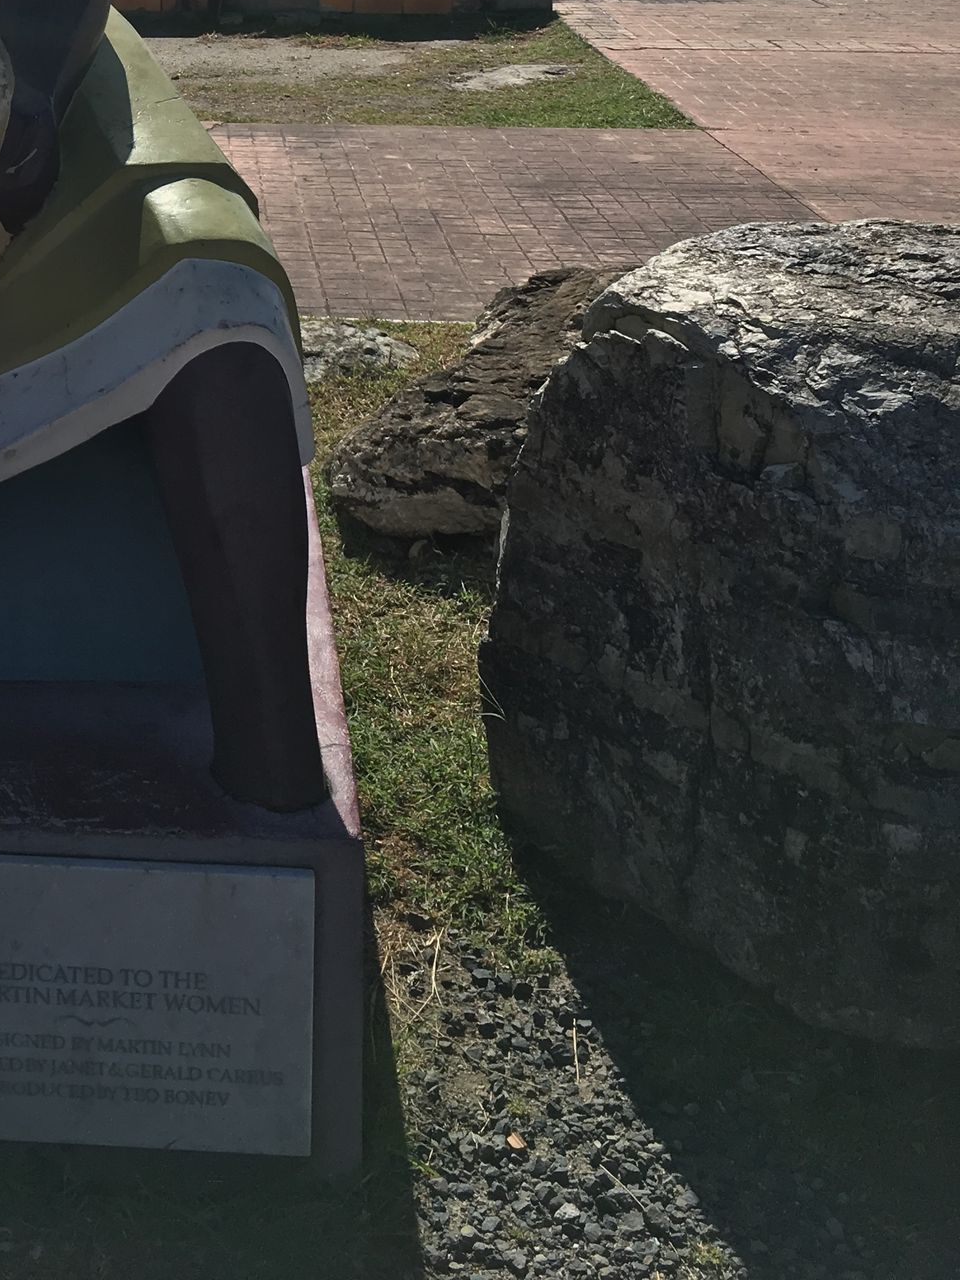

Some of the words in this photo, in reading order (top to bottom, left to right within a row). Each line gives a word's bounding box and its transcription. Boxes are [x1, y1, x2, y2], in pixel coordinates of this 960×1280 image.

[118, 968, 153, 988] TO
[159, 970, 208, 990] THE
[56, 988, 157, 1011] MARKET
[162, 993, 262, 1017] WOMEN
[71, 1036, 94, 1052] BY
[97, 1037, 172, 1056] MARTIN
[178, 1042, 232, 1058] LYNN
[26, 1057, 47, 1073] BY
[108, 1062, 124, 1078] &
[125, 1063, 203, 1082] GERALD
